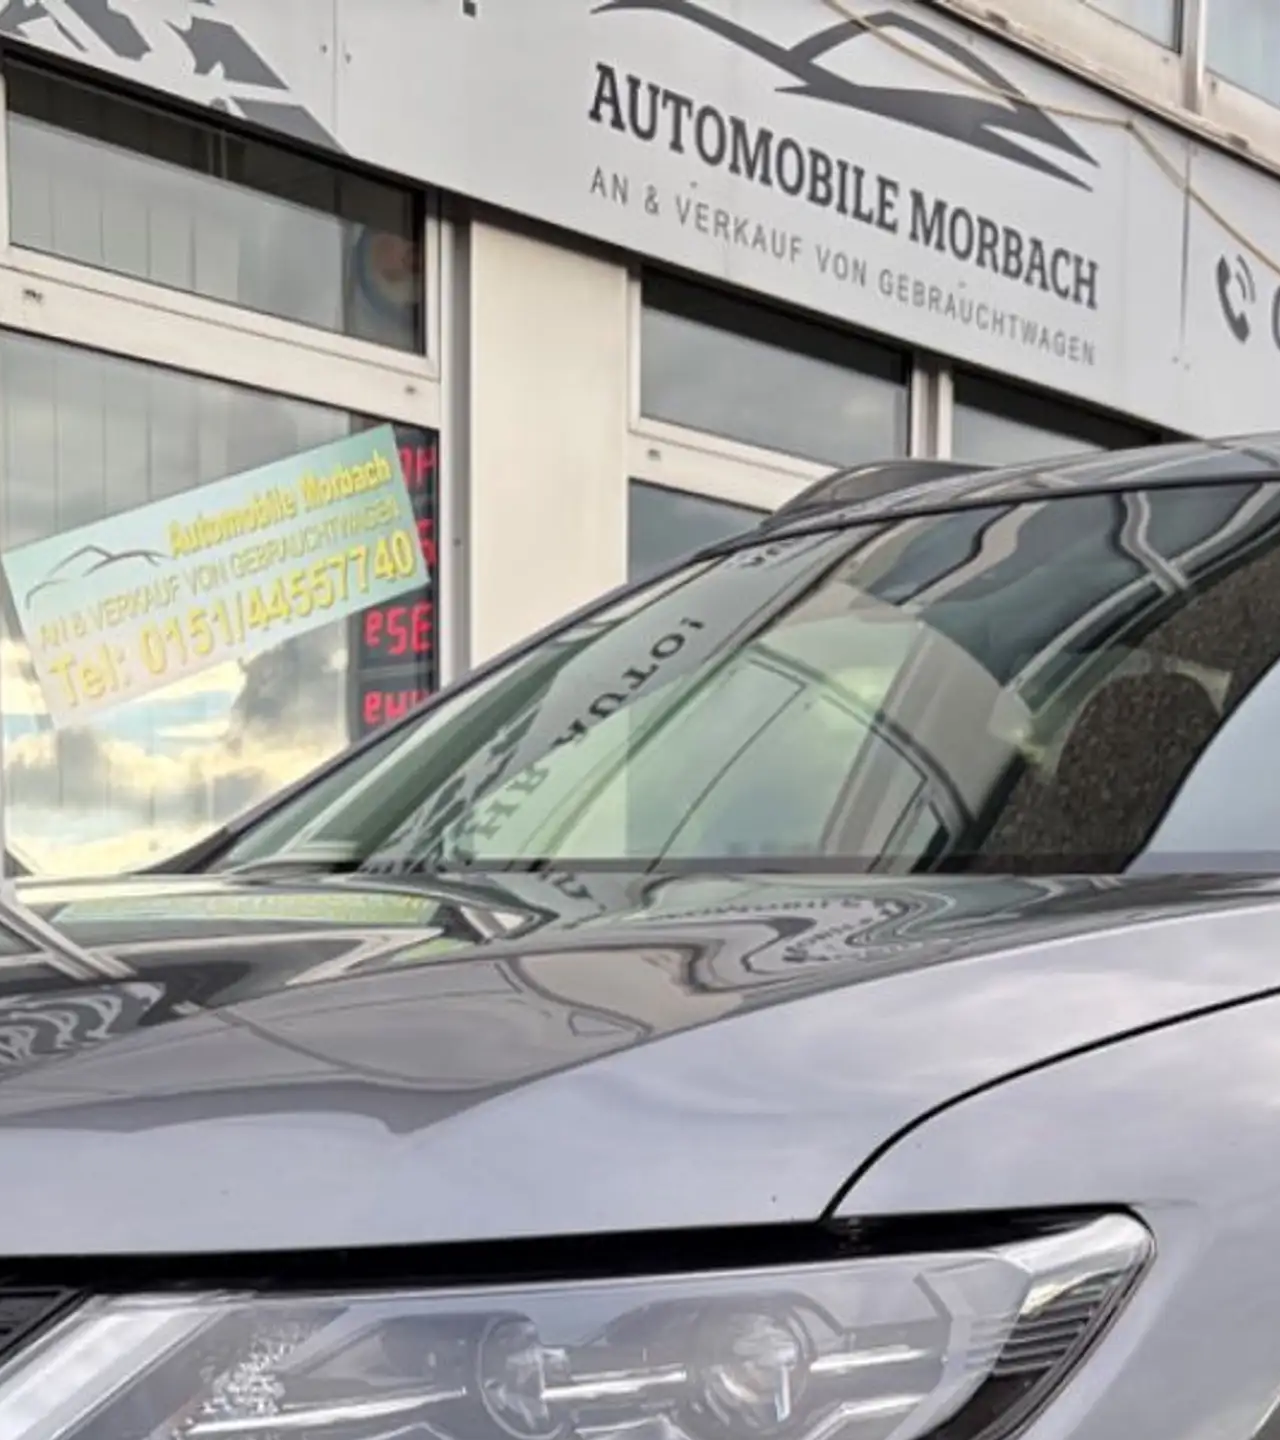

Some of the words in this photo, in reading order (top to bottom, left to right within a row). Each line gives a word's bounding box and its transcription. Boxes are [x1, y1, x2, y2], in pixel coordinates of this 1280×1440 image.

[588, 63, 899, 235] AUTOMOBILE
[908, 189, 1099, 309] MORBACH
[589, 165, 628, 207] AN
[644, 183, 660, 216] &
[675, 195, 803, 264] VERKAUF
[815, 243, 867, 289] VON
[878, 268, 1097, 366] GEBRAUCHTWAGEN
[167, 485, 297, 560] Automobile
[299, 449, 392, 512] Morbach
[48, 646, 133, 708] Tel:
[138, 528, 415, 676] 0151/44557740
